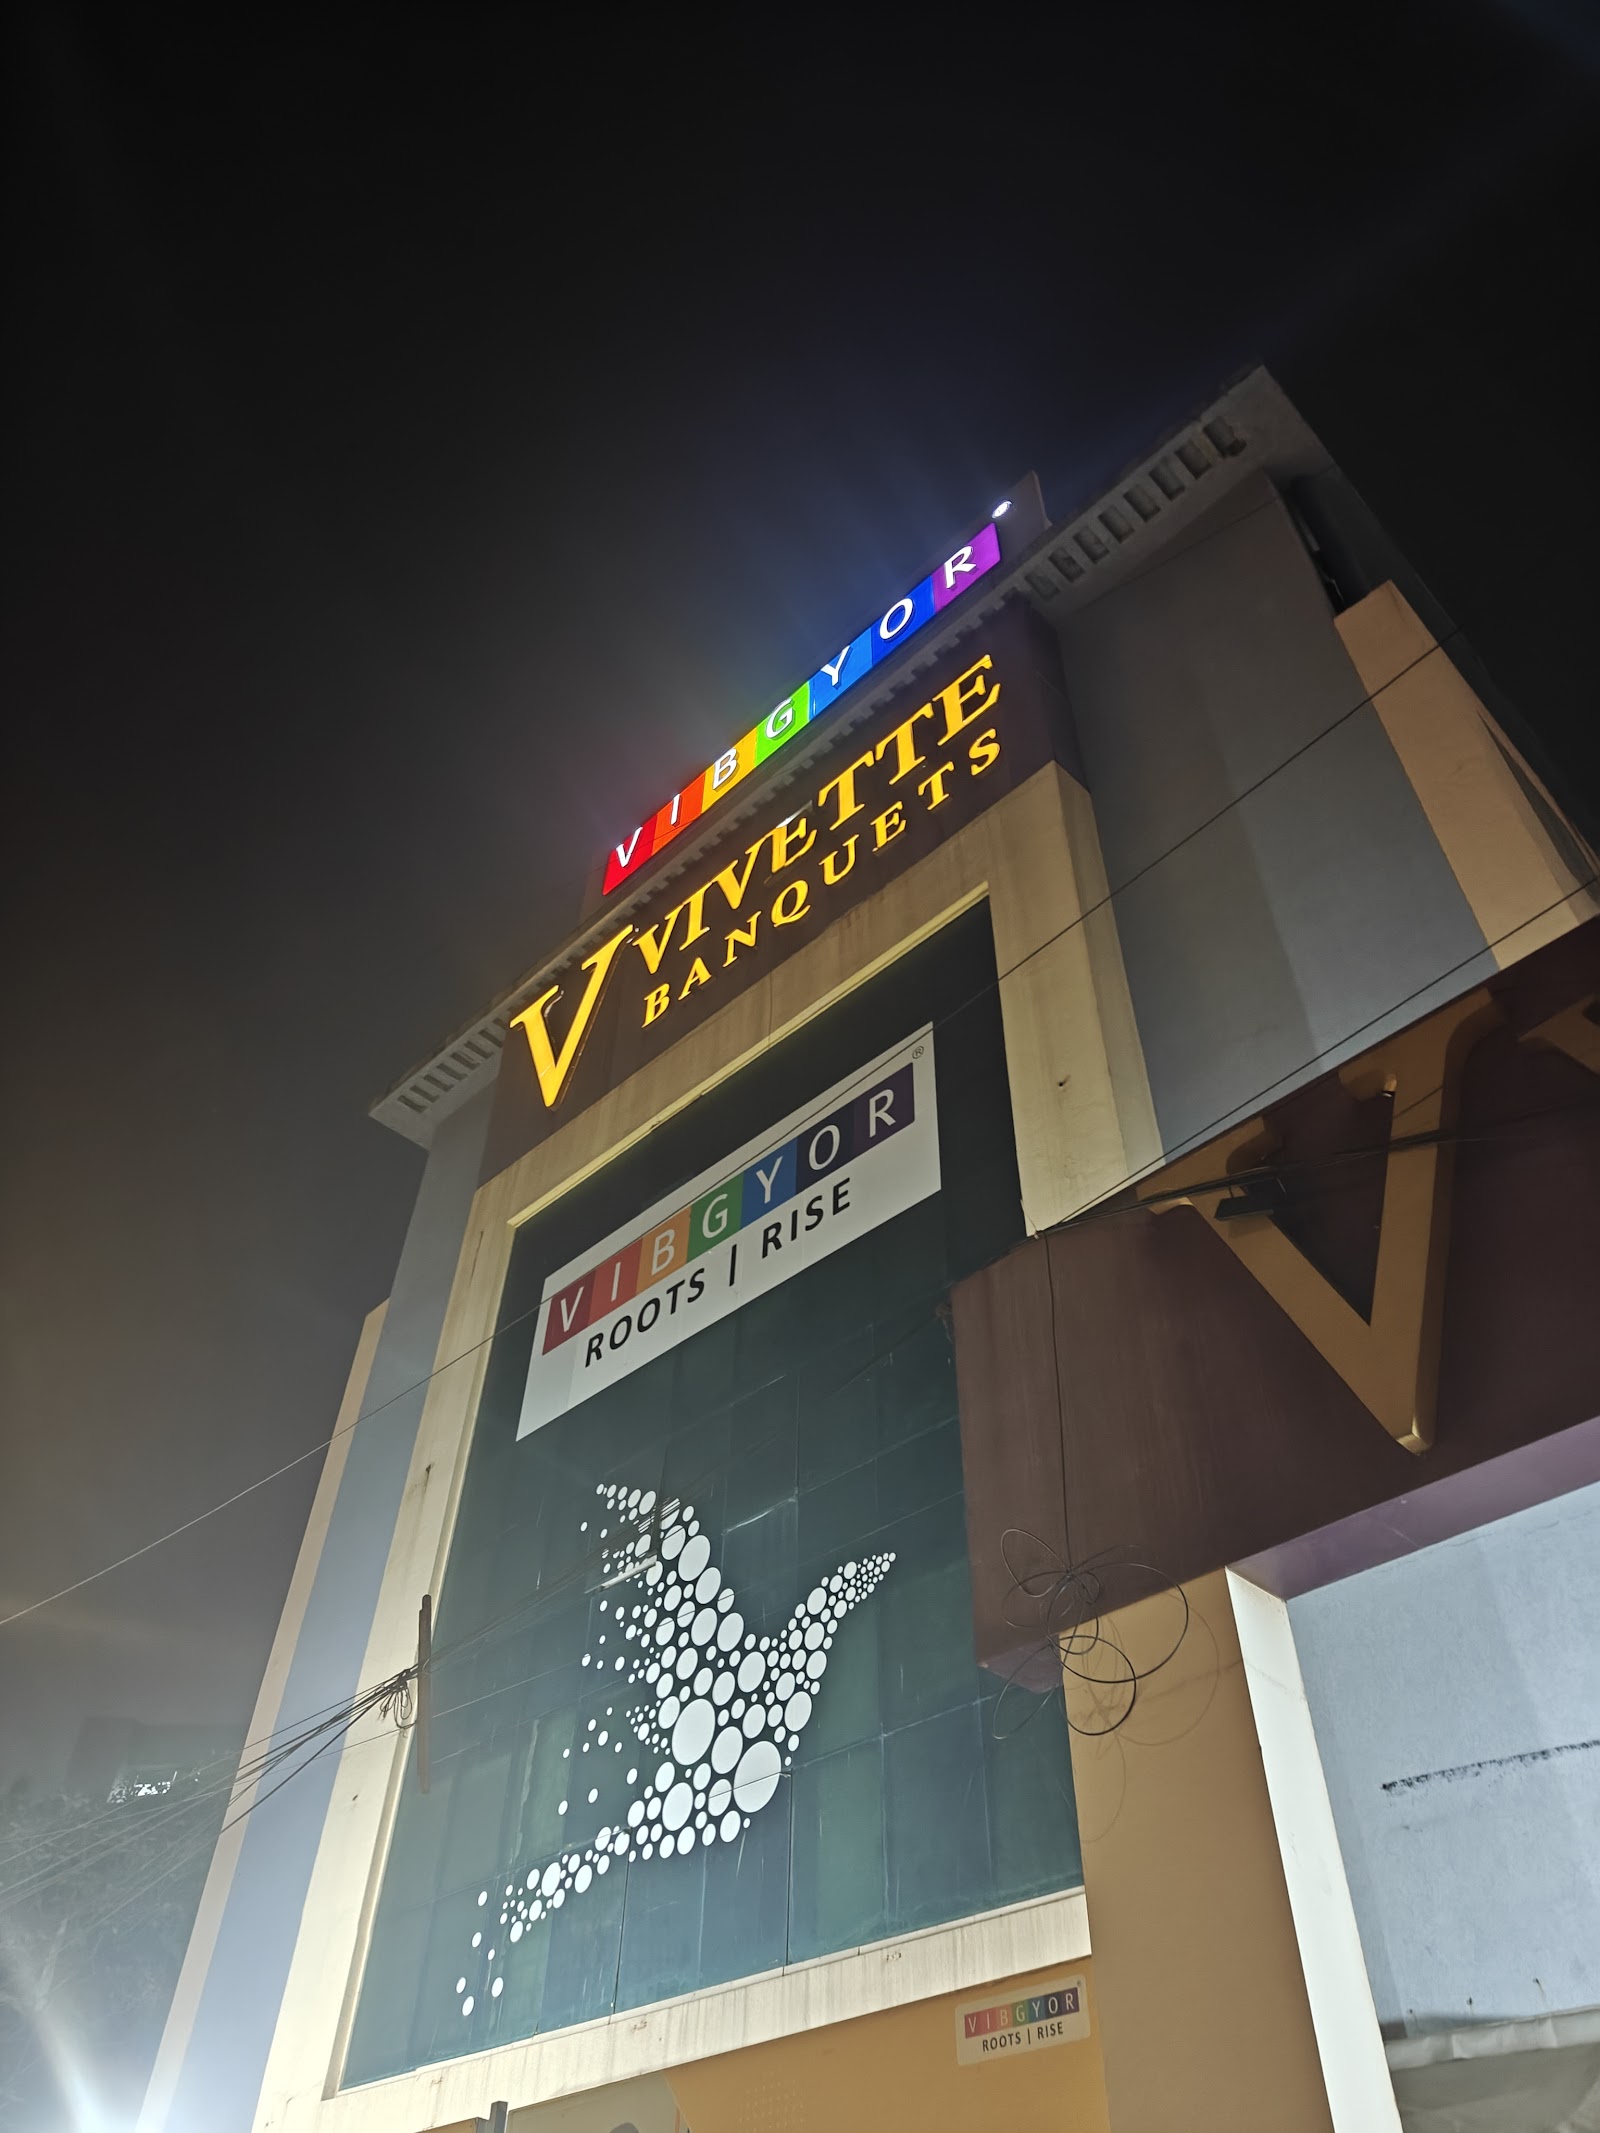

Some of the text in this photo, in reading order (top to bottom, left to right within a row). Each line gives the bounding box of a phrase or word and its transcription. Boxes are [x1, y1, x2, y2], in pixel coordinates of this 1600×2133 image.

[615, 545, 976, 869] VIBGYOR
[633, 654, 1001, 975] VIVETTE
[642, 728, 1001, 1029] BANQUETS
[560, 1088, 897, 1333] VIBGYOR
[584, 1268, 706, 1368] ROOTS
[761, 1177, 851, 1259] RISE
[967, 1992, 1075, 2034] VIBGYOR
[982, 2031, 1021, 2053] ROOTS
[1037, 2021, 1064, 2040] RISE
